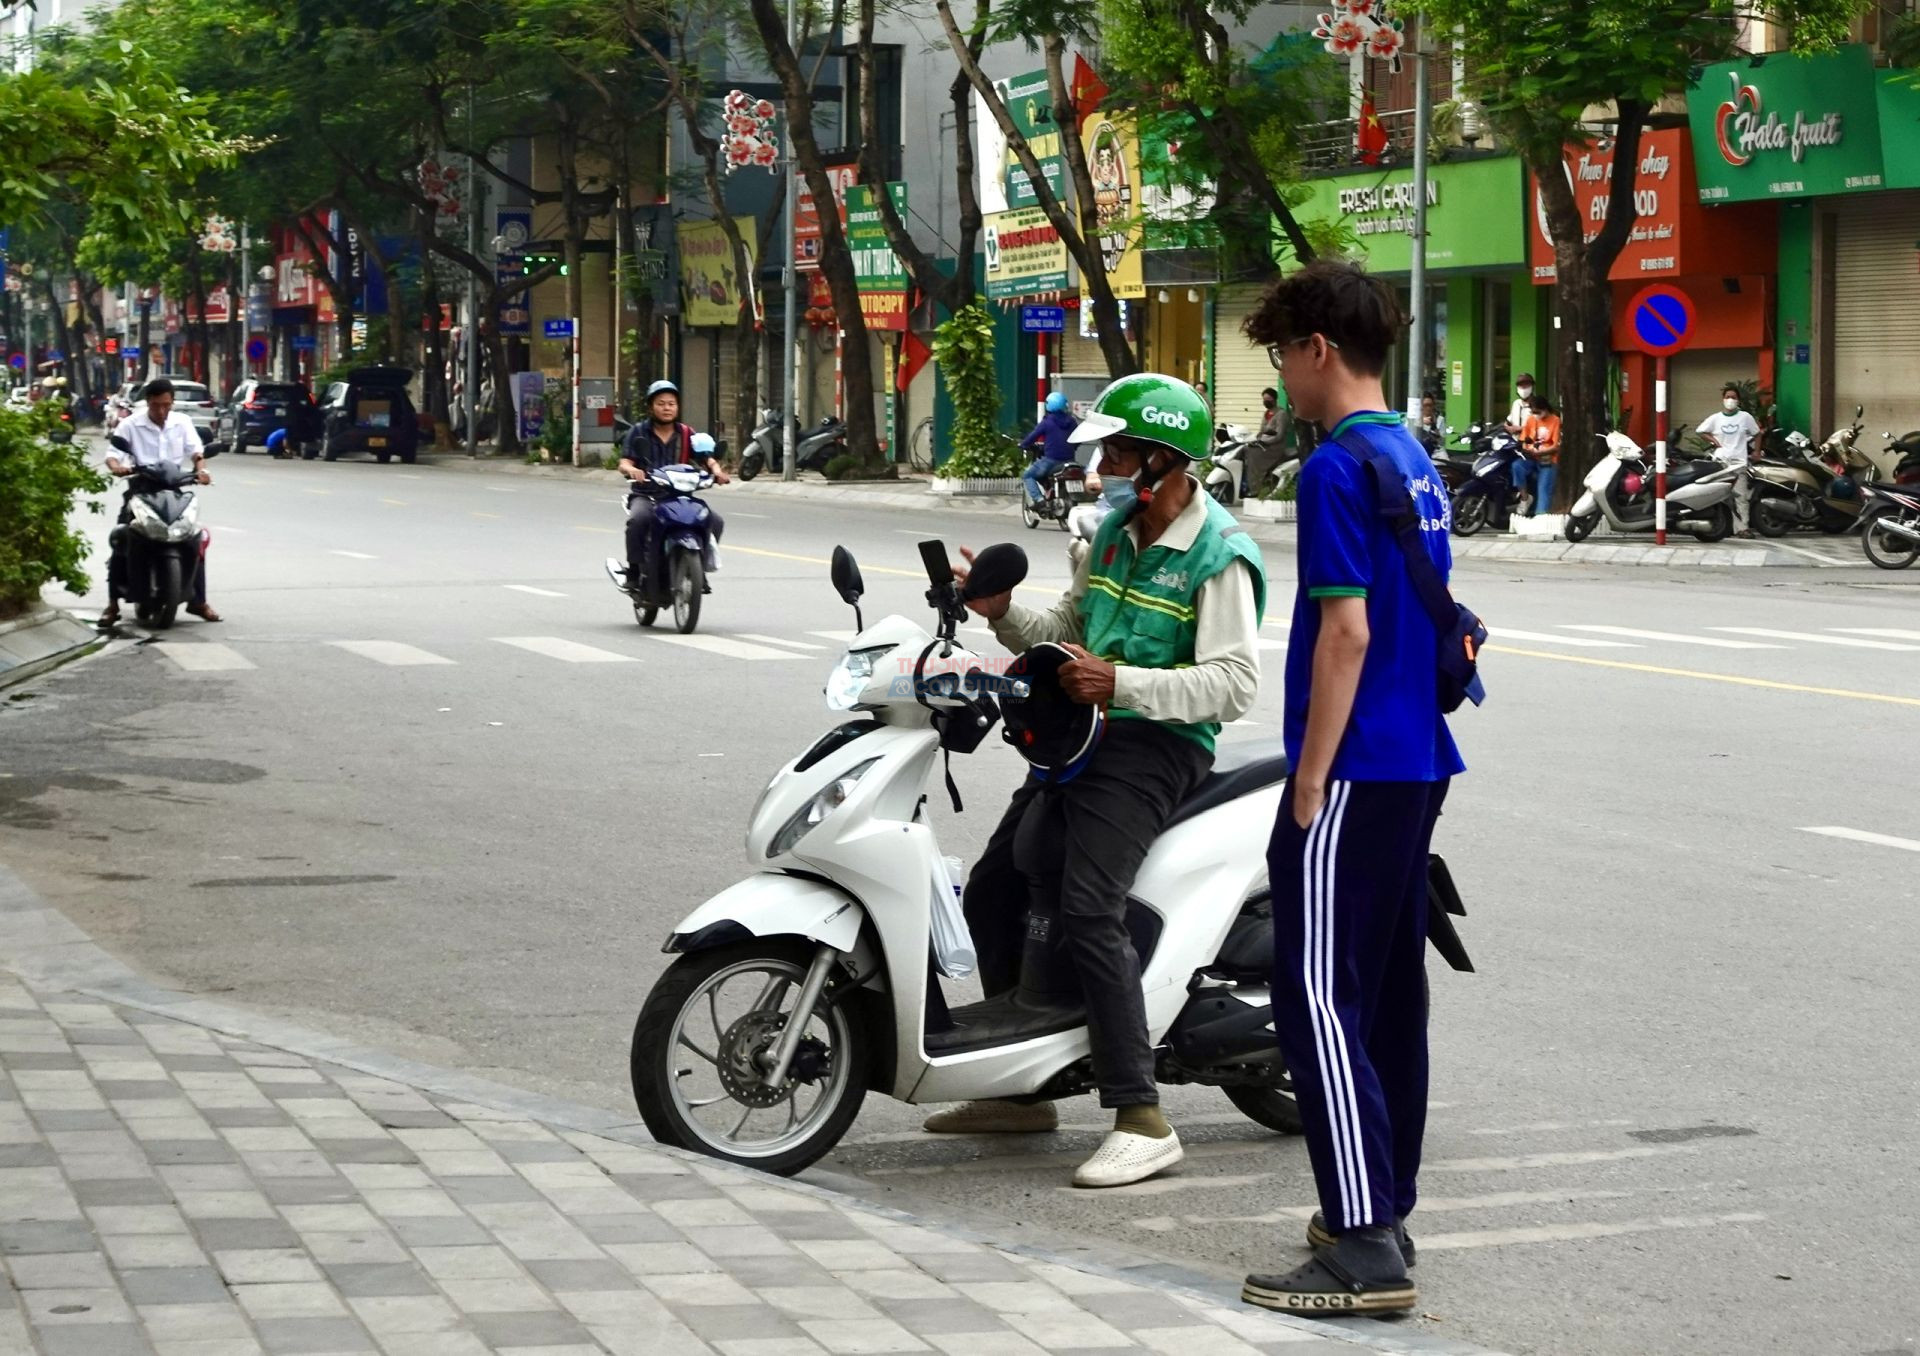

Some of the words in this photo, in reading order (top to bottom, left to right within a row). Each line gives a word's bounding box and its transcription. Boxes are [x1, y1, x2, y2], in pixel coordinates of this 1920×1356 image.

[1734, 111, 1787, 151] Hala
[1790, 111, 1840, 162] fruit
[1641, 145, 1669, 180] chay
[1338, 187, 1379, 214] FRESH
[1381, 180, 1437, 209] GARDN
[859, 295, 905, 313] OTOCOPY
[1141, 405, 1190, 431] Grab
[1288, 1294, 1354, 1308] crocs
